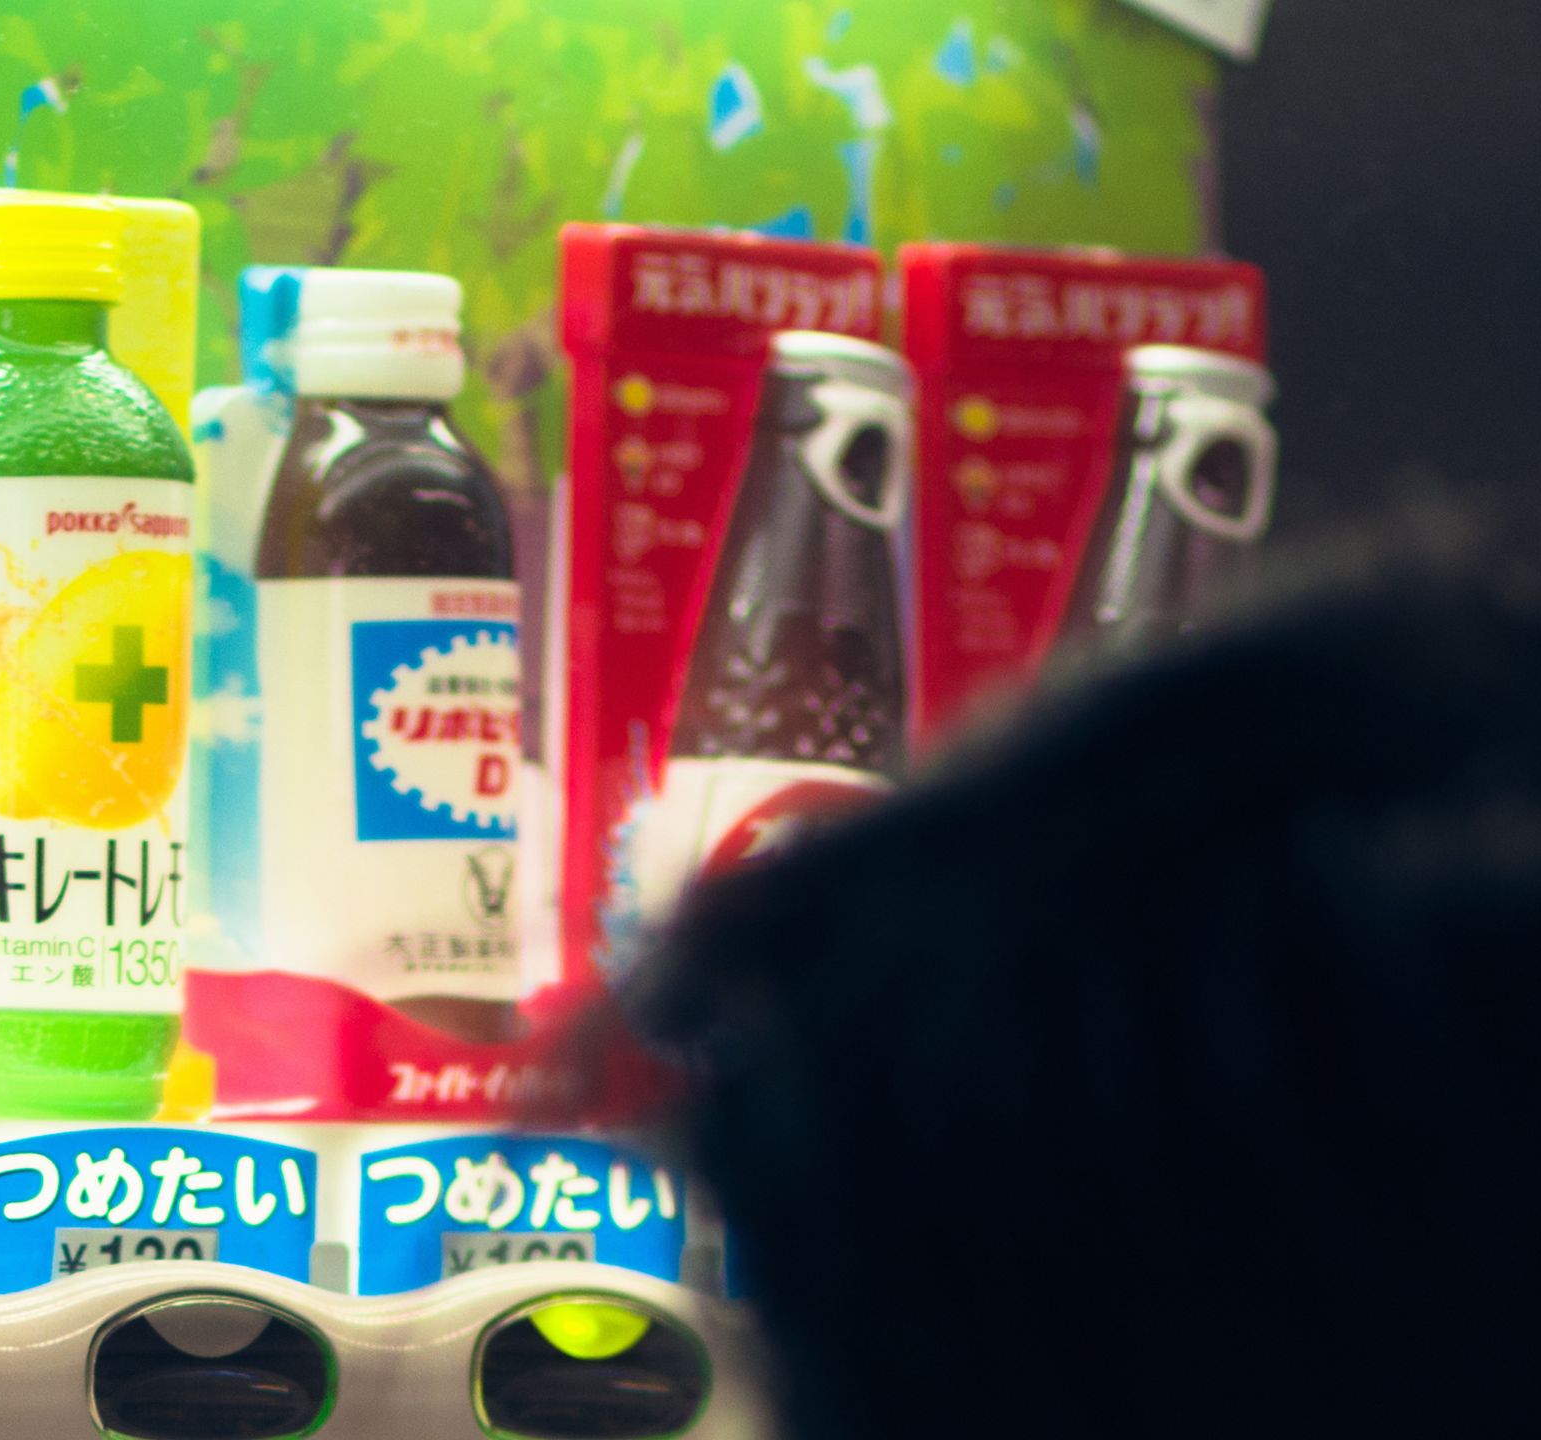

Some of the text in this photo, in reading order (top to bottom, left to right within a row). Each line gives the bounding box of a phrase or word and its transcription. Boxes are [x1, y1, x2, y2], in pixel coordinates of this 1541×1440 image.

[77, 936, 96, 958] C
[366, 1152, 679, 1232] つめたい
